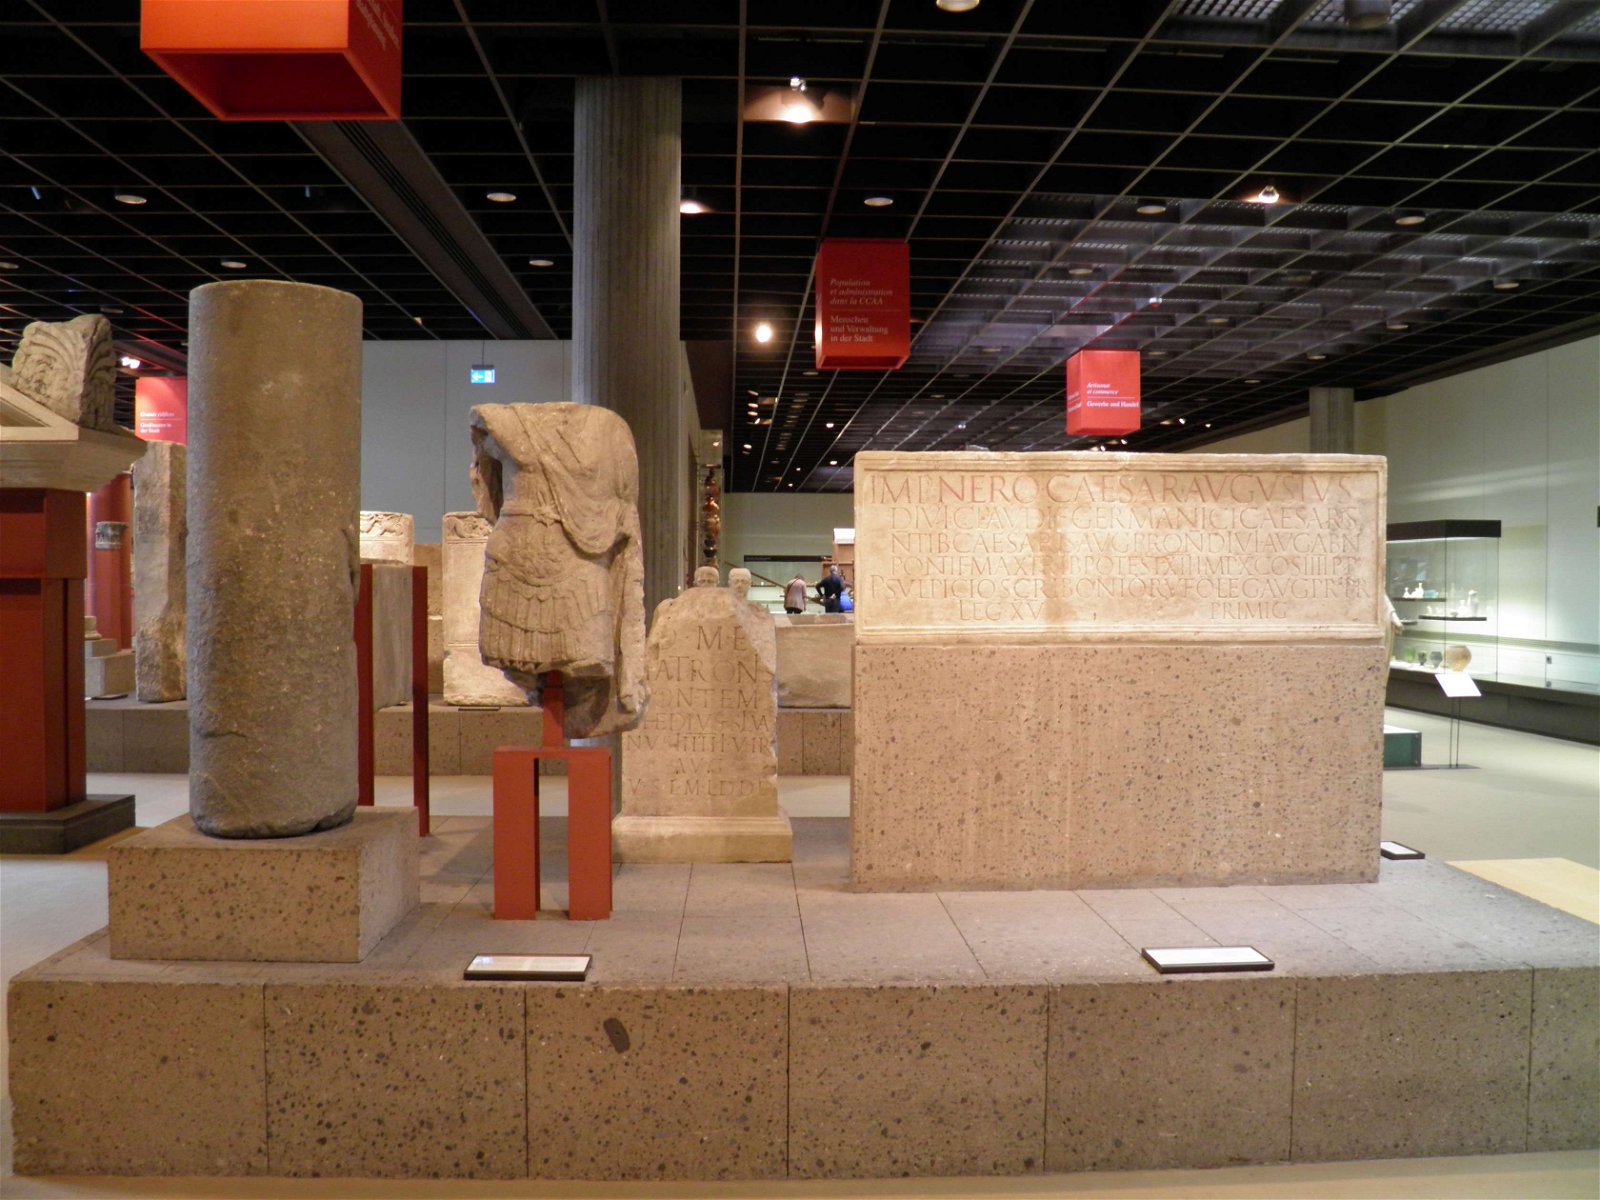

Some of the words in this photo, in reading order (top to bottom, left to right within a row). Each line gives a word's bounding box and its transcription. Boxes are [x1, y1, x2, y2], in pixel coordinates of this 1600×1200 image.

[830, 279, 871, 288] Population
[839, 288, 894, 296] administration
[830, 325, 845, 333] und
[846, 325, 888, 335] Verwaltung
[870, 474, 932, 504] IMP
[938, 474, 1038, 504] NERO
[1046, 474, 1182, 504] CAESAR
[959, 600, 1001, 621] LEG
[1210, 601, 1288, 620] PRIMIG
